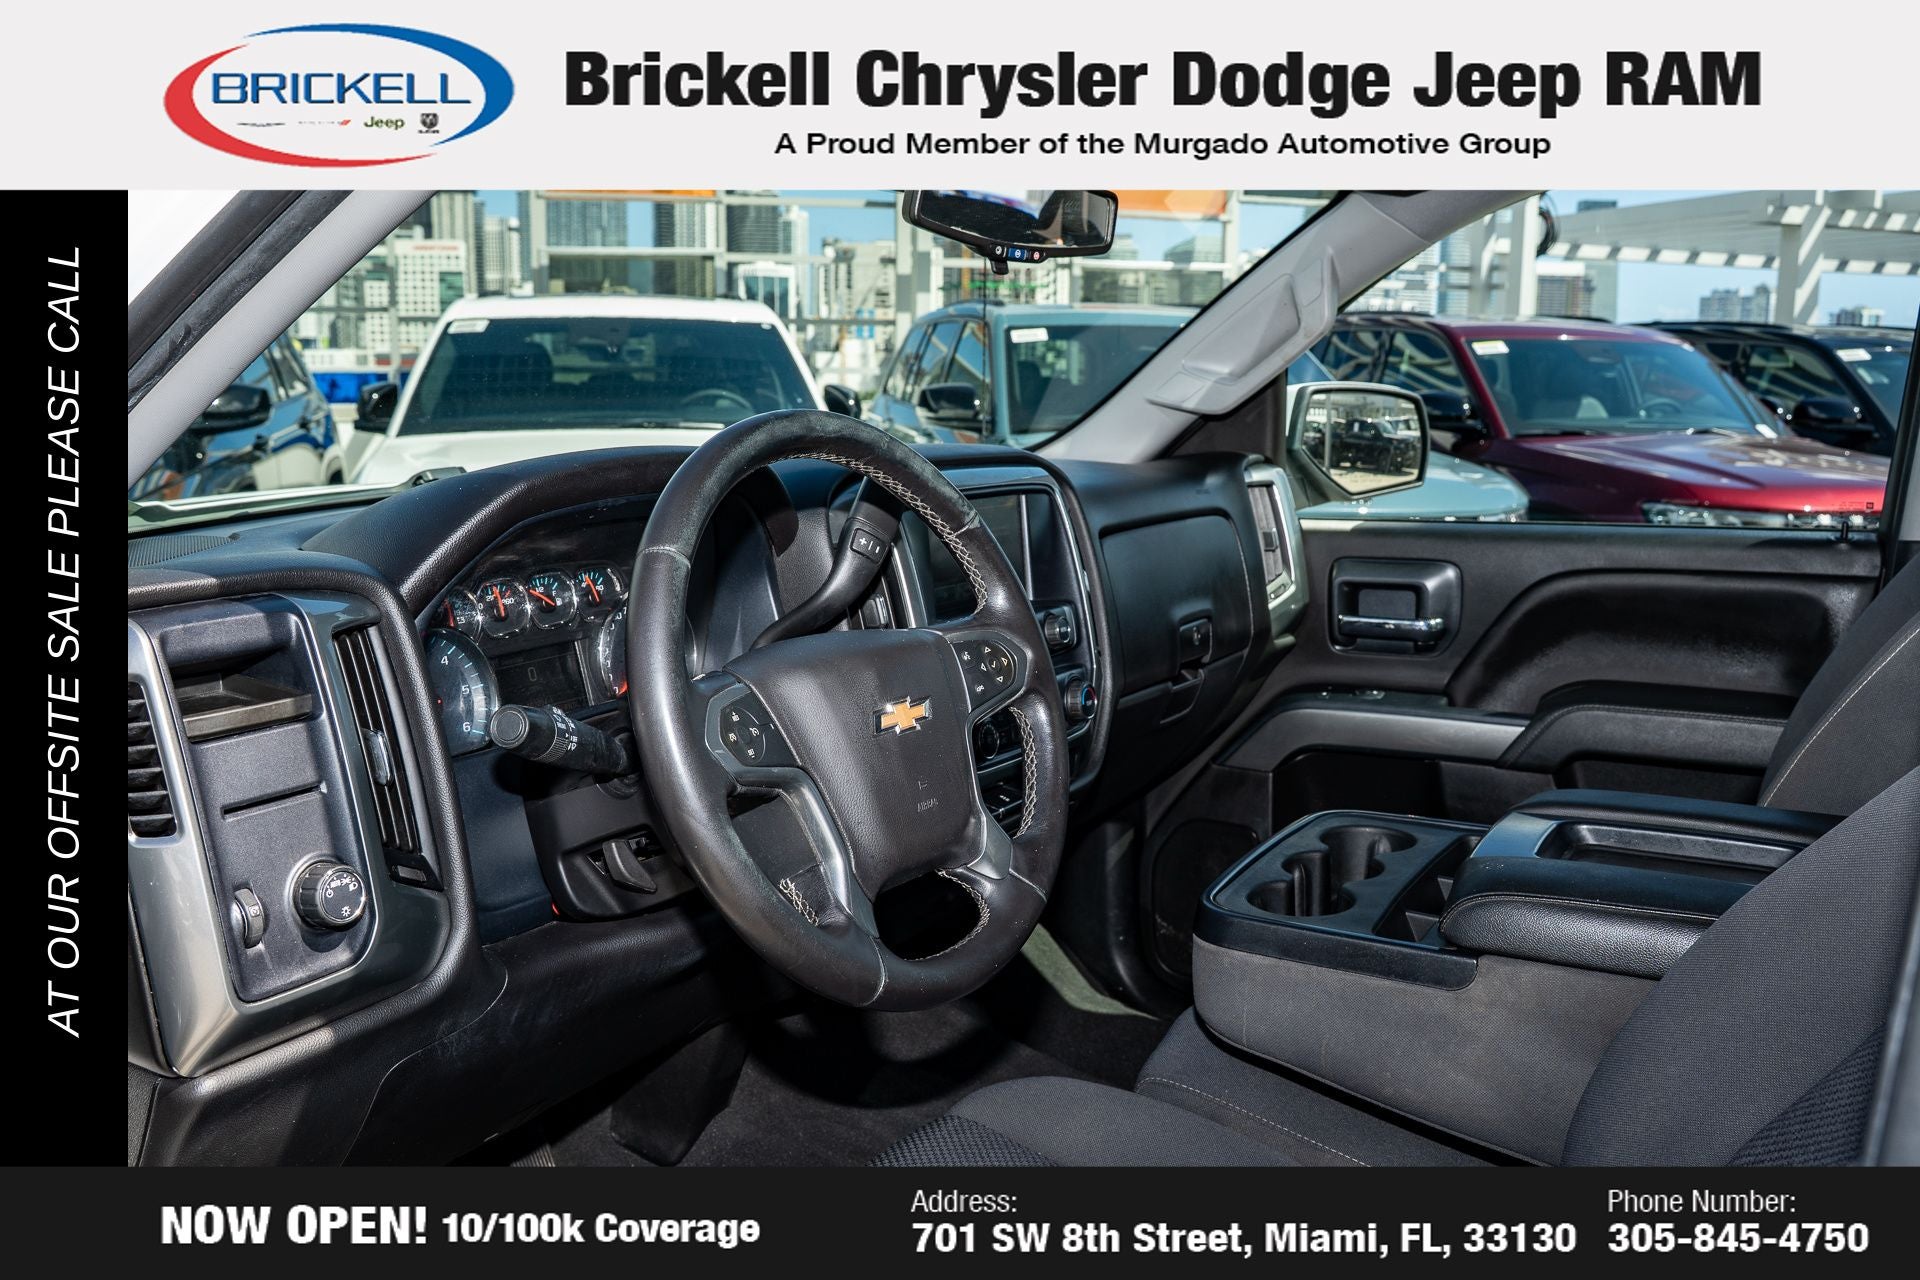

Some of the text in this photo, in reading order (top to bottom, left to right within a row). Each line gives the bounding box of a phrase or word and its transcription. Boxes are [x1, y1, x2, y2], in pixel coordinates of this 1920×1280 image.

[440, 655, 449, 666] 4
[461, 684, 470, 695] 5
[462, 721, 471, 732] 6
